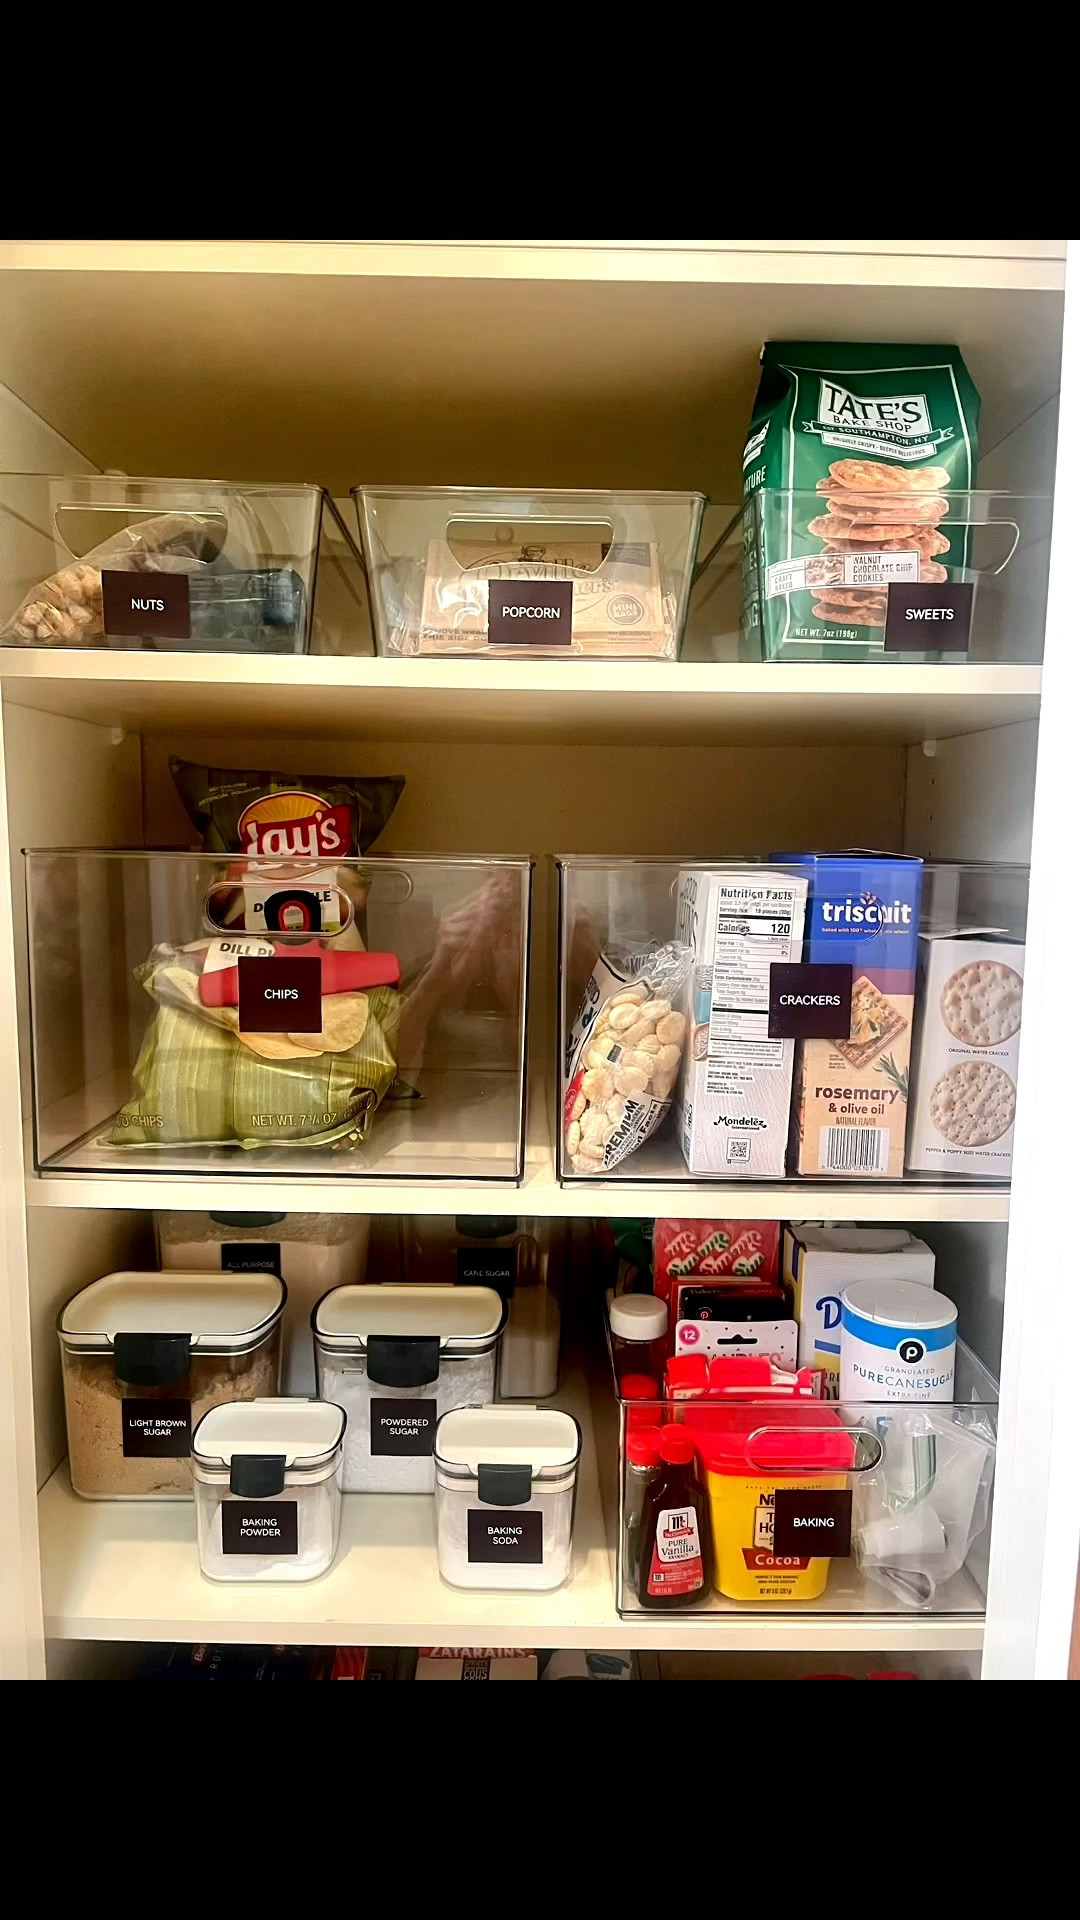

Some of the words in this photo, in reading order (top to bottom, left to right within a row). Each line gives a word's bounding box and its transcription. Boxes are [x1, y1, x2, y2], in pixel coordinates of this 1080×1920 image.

[825, 384, 922, 424] TATE'S
[833, 415, 870, 427] BAKE
[876, 420, 912, 433] SHOP
[914, 435, 929, 444] NY
[853, 556, 881, 565] WALNUT
[853, 564, 894, 574] CHOCOLATE
[853, 574, 884, 583] COOKIES
[131, 598, 164, 611] NUTS
[502, 607, 560, 619] POPCORN
[905, 609, 954, 620] SWEETS
[795, 628, 808, 636] NET
[721, 888, 763, 899] Nutrition
[766, 890, 793, 900] Facts
[822, 899, 912, 923] triscuit
[718, 923, 750, 932] Calories
[772, 924, 790, 934] 120
[219, 943, 252, 956] DILL
[264, 989, 298, 999] CHIPS
[779, 994, 841, 1006] CRACKERS
[815, 1087, 899, 1104] rosemary
[828, 1103, 837, 1113] &
[840, 1103, 868, 1114] olive
[871, 1104, 885, 1115] oil
[131, 1115, 164, 1128] CHIPS
[252, 1115, 273, 1126] NET
[277, 1114, 297, 1126] WT.
[323, 1113, 337, 1124] OZ
[242, 1261, 276, 1269] PURPOSE
[683, 1330, 696, 1340] 12
[884, 1365, 935, 1375] GRANULATED
[129, 1419, 153, 1428] LIGHT
[155, 1419, 186, 1428] BROWN
[381, 1418, 429, 1427] POWDERED
[143, 1428, 171, 1436] SUGAR
[389, 1427, 419, 1436] SUGAR
[242, 1518, 278, 1527] BAKING
[793, 1518, 835, 1528] BAKING
[240, 1528, 281, 1537] POWDER
[487, 1526, 523, 1535] BAKING
[492, 1537, 519, 1545] SODA
[668, 1539, 687, 1547] PURE
[661, 1544, 694, 1556] Vanilla
[755, 1554, 800, 1565] Cocoa
